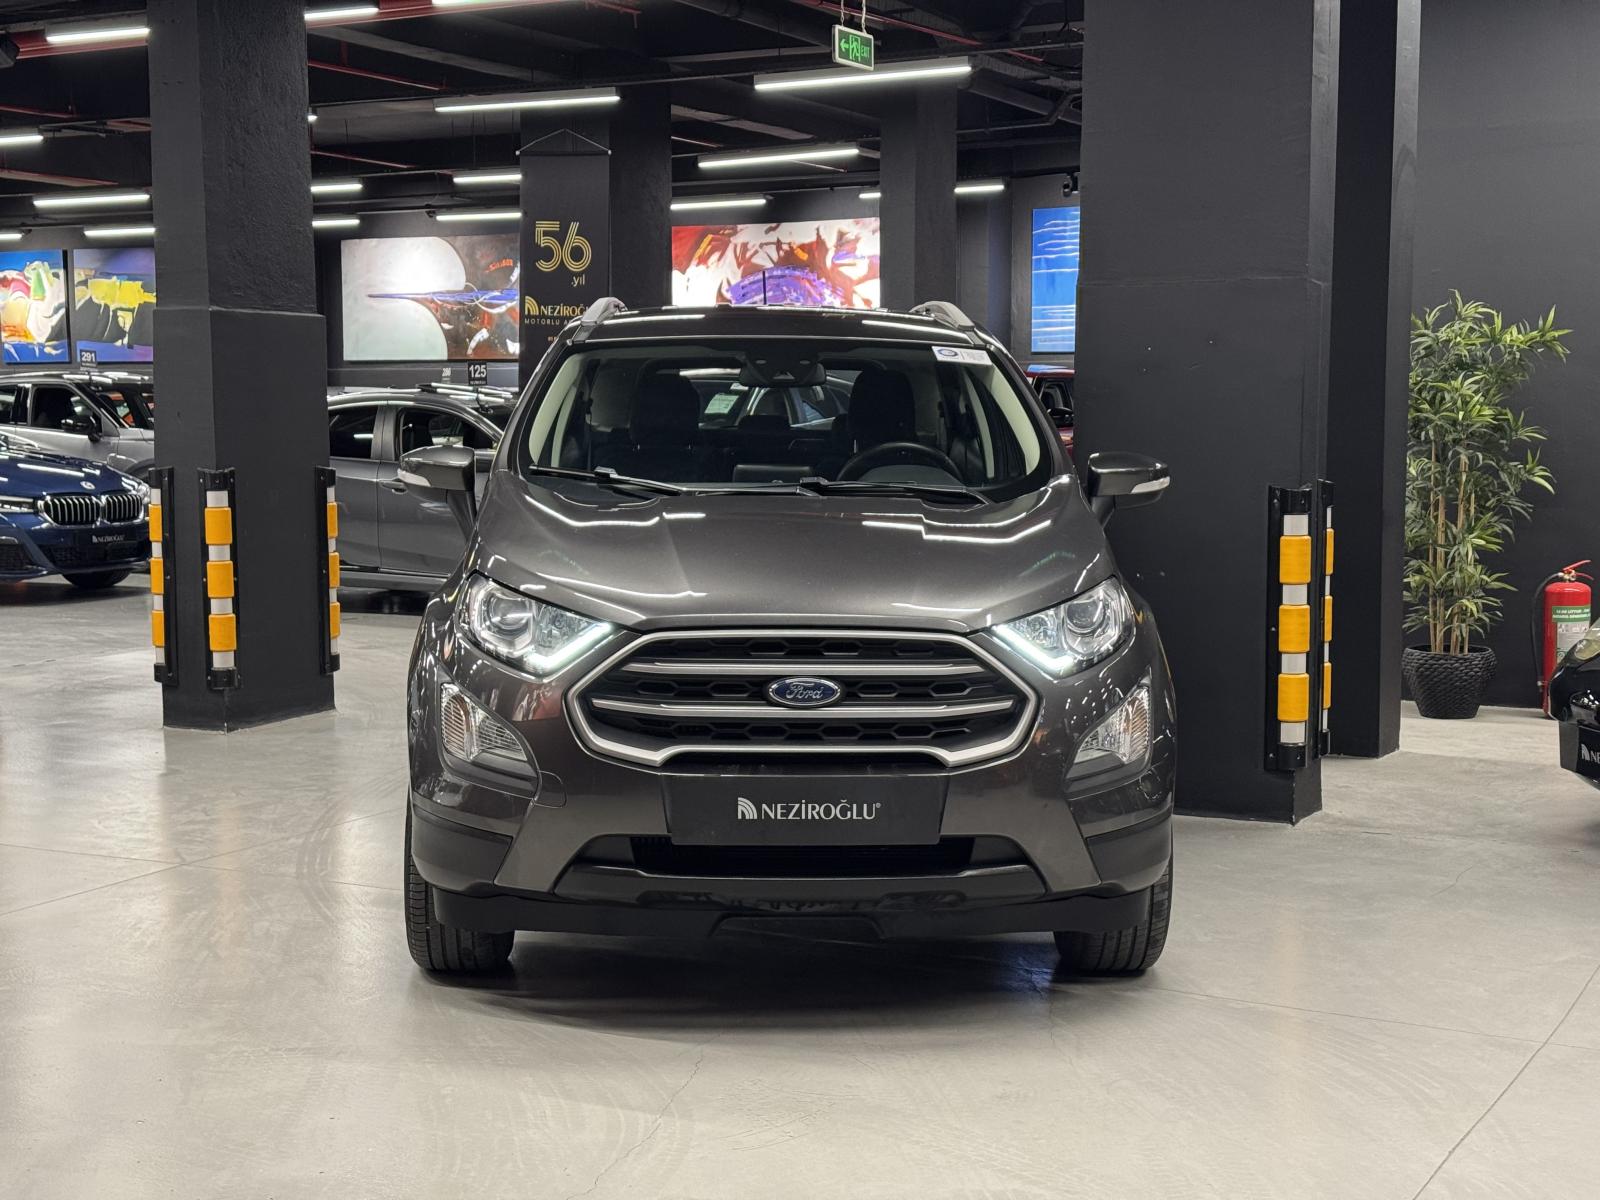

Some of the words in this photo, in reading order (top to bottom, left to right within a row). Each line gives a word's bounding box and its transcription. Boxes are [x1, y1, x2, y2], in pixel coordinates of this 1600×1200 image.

[535, 221, 591, 272] 56
[540, 303, 588, 317] NEZİROĞ
[81, 352, 95, 362] 291
[469, 364, 487, 378] 125
[785, 682, 824, 699] Ford
